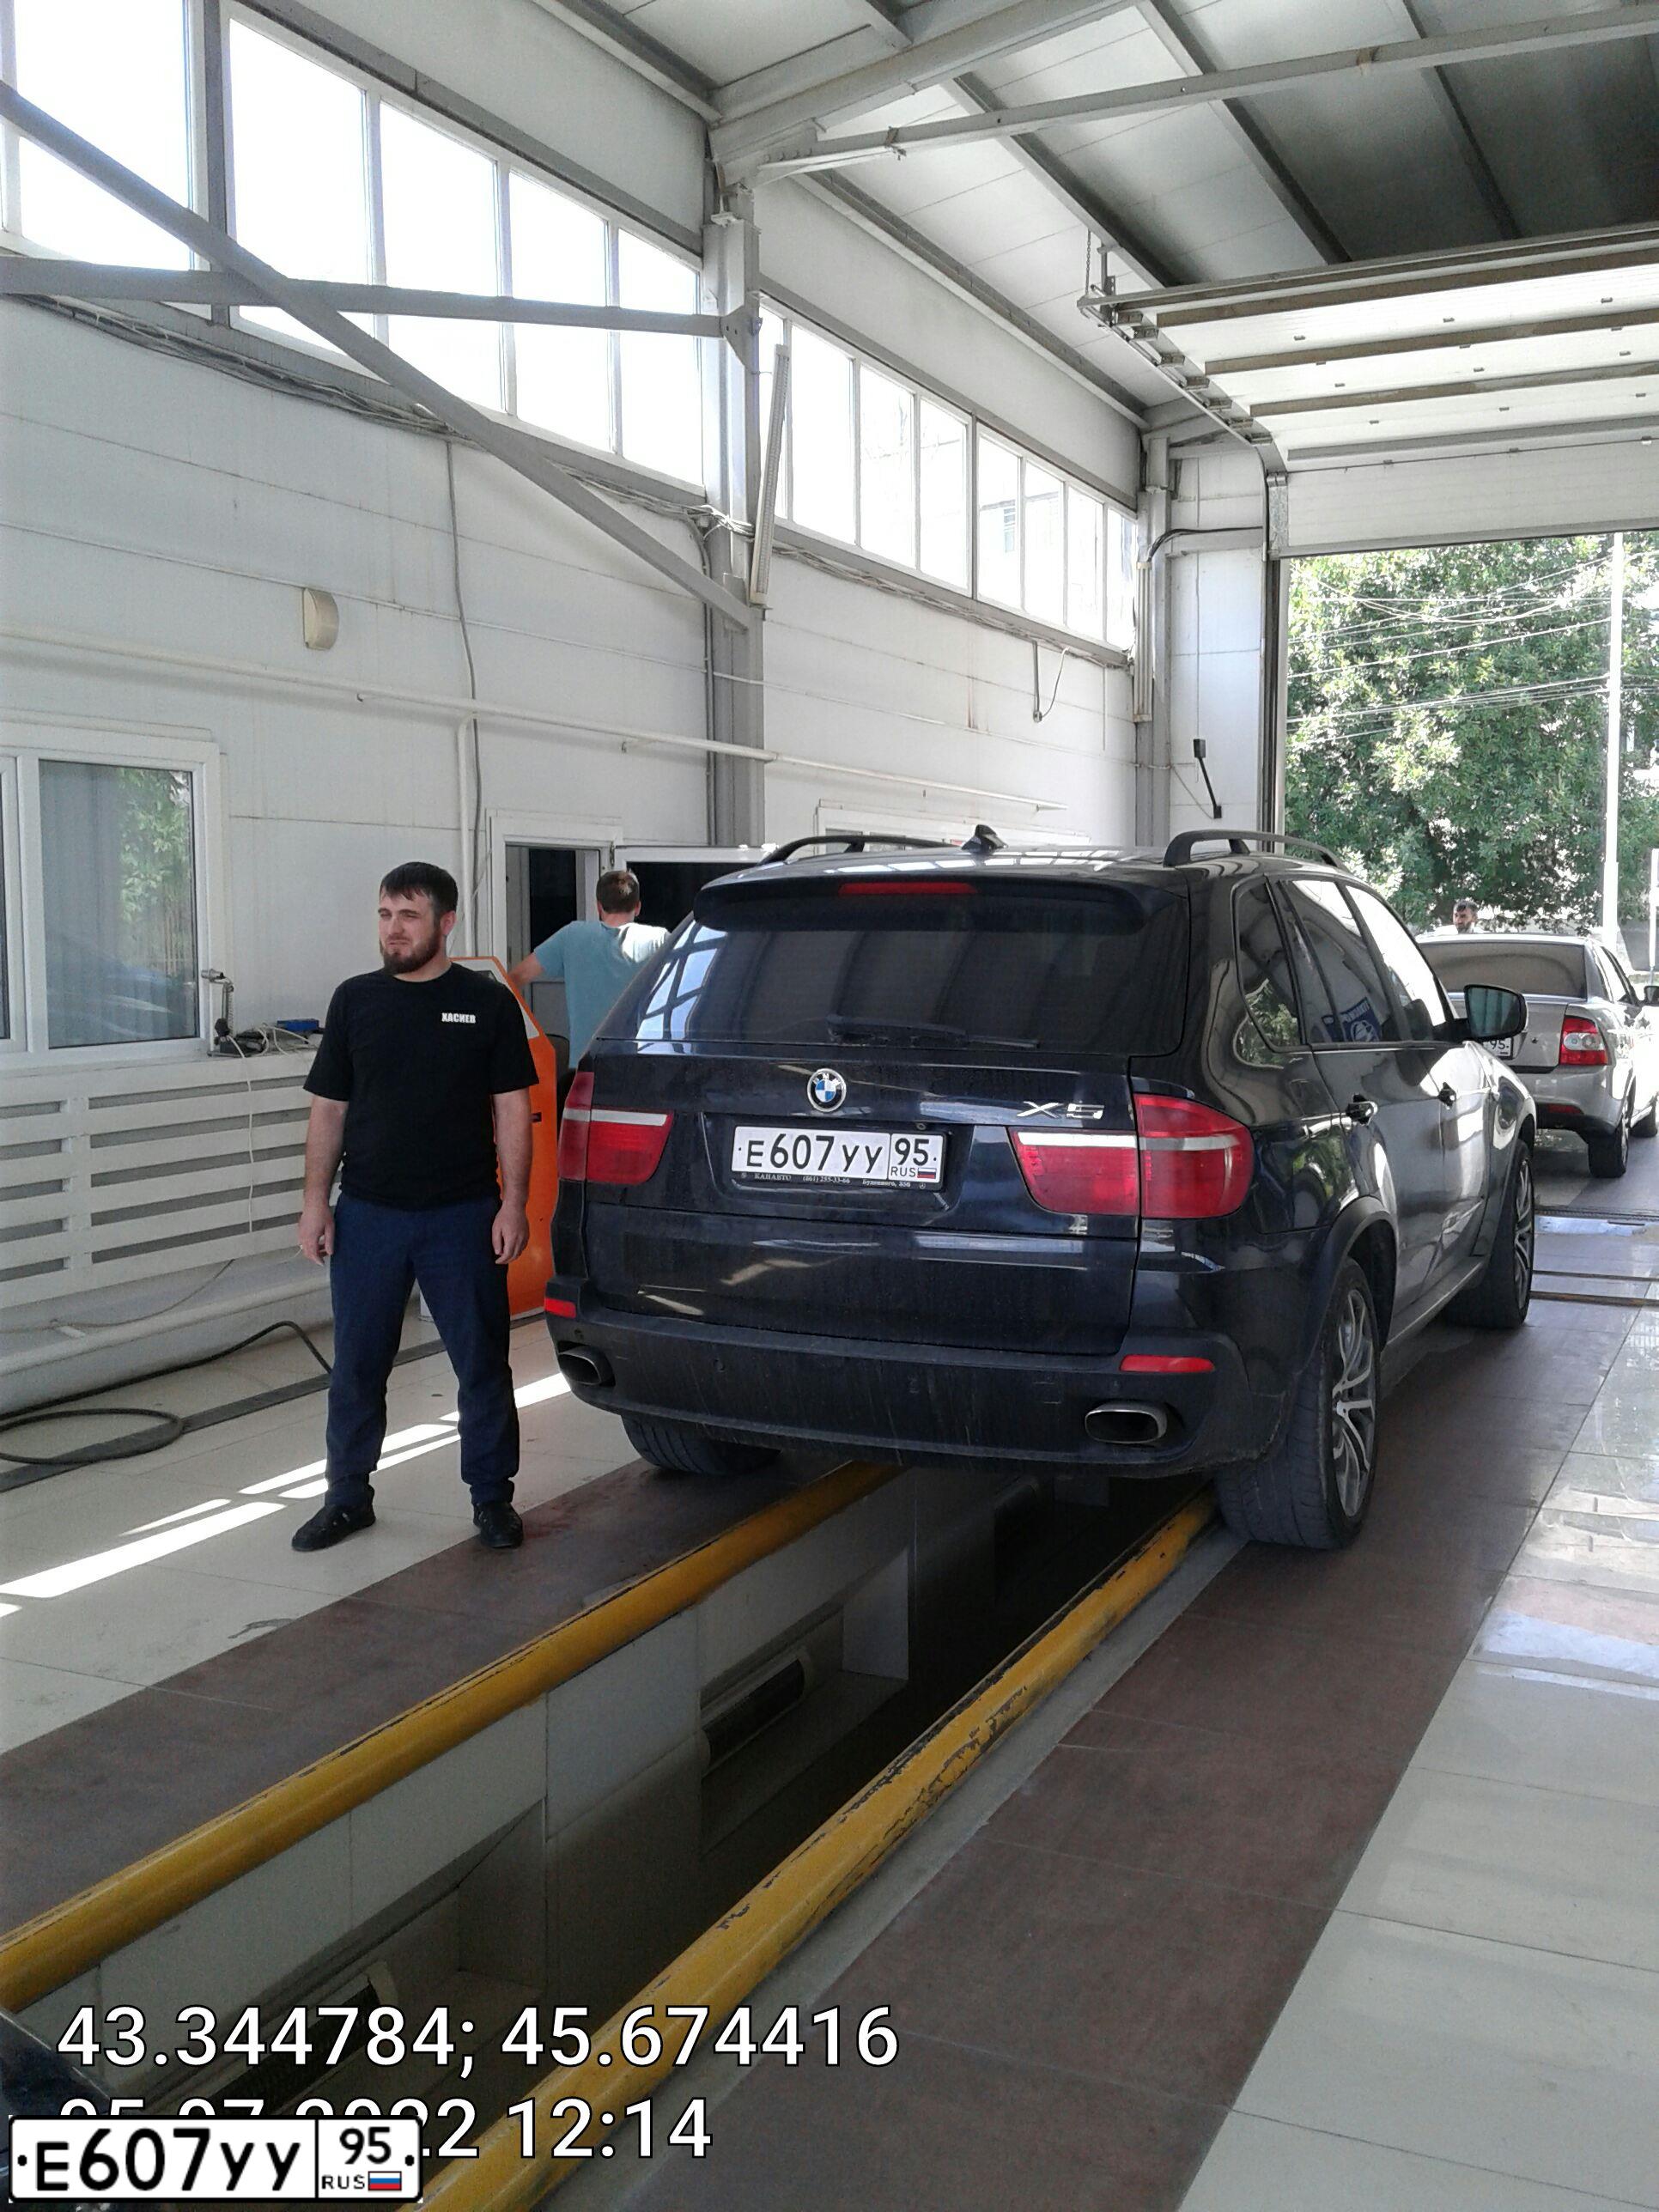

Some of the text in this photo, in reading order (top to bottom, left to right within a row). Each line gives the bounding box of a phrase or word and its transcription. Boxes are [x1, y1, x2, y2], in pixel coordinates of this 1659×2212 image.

[1017, 1101, 1104, 1120] X5
[895, 1138, 929, 1166] 95
[890, 1166, 916, 1177] RUS
